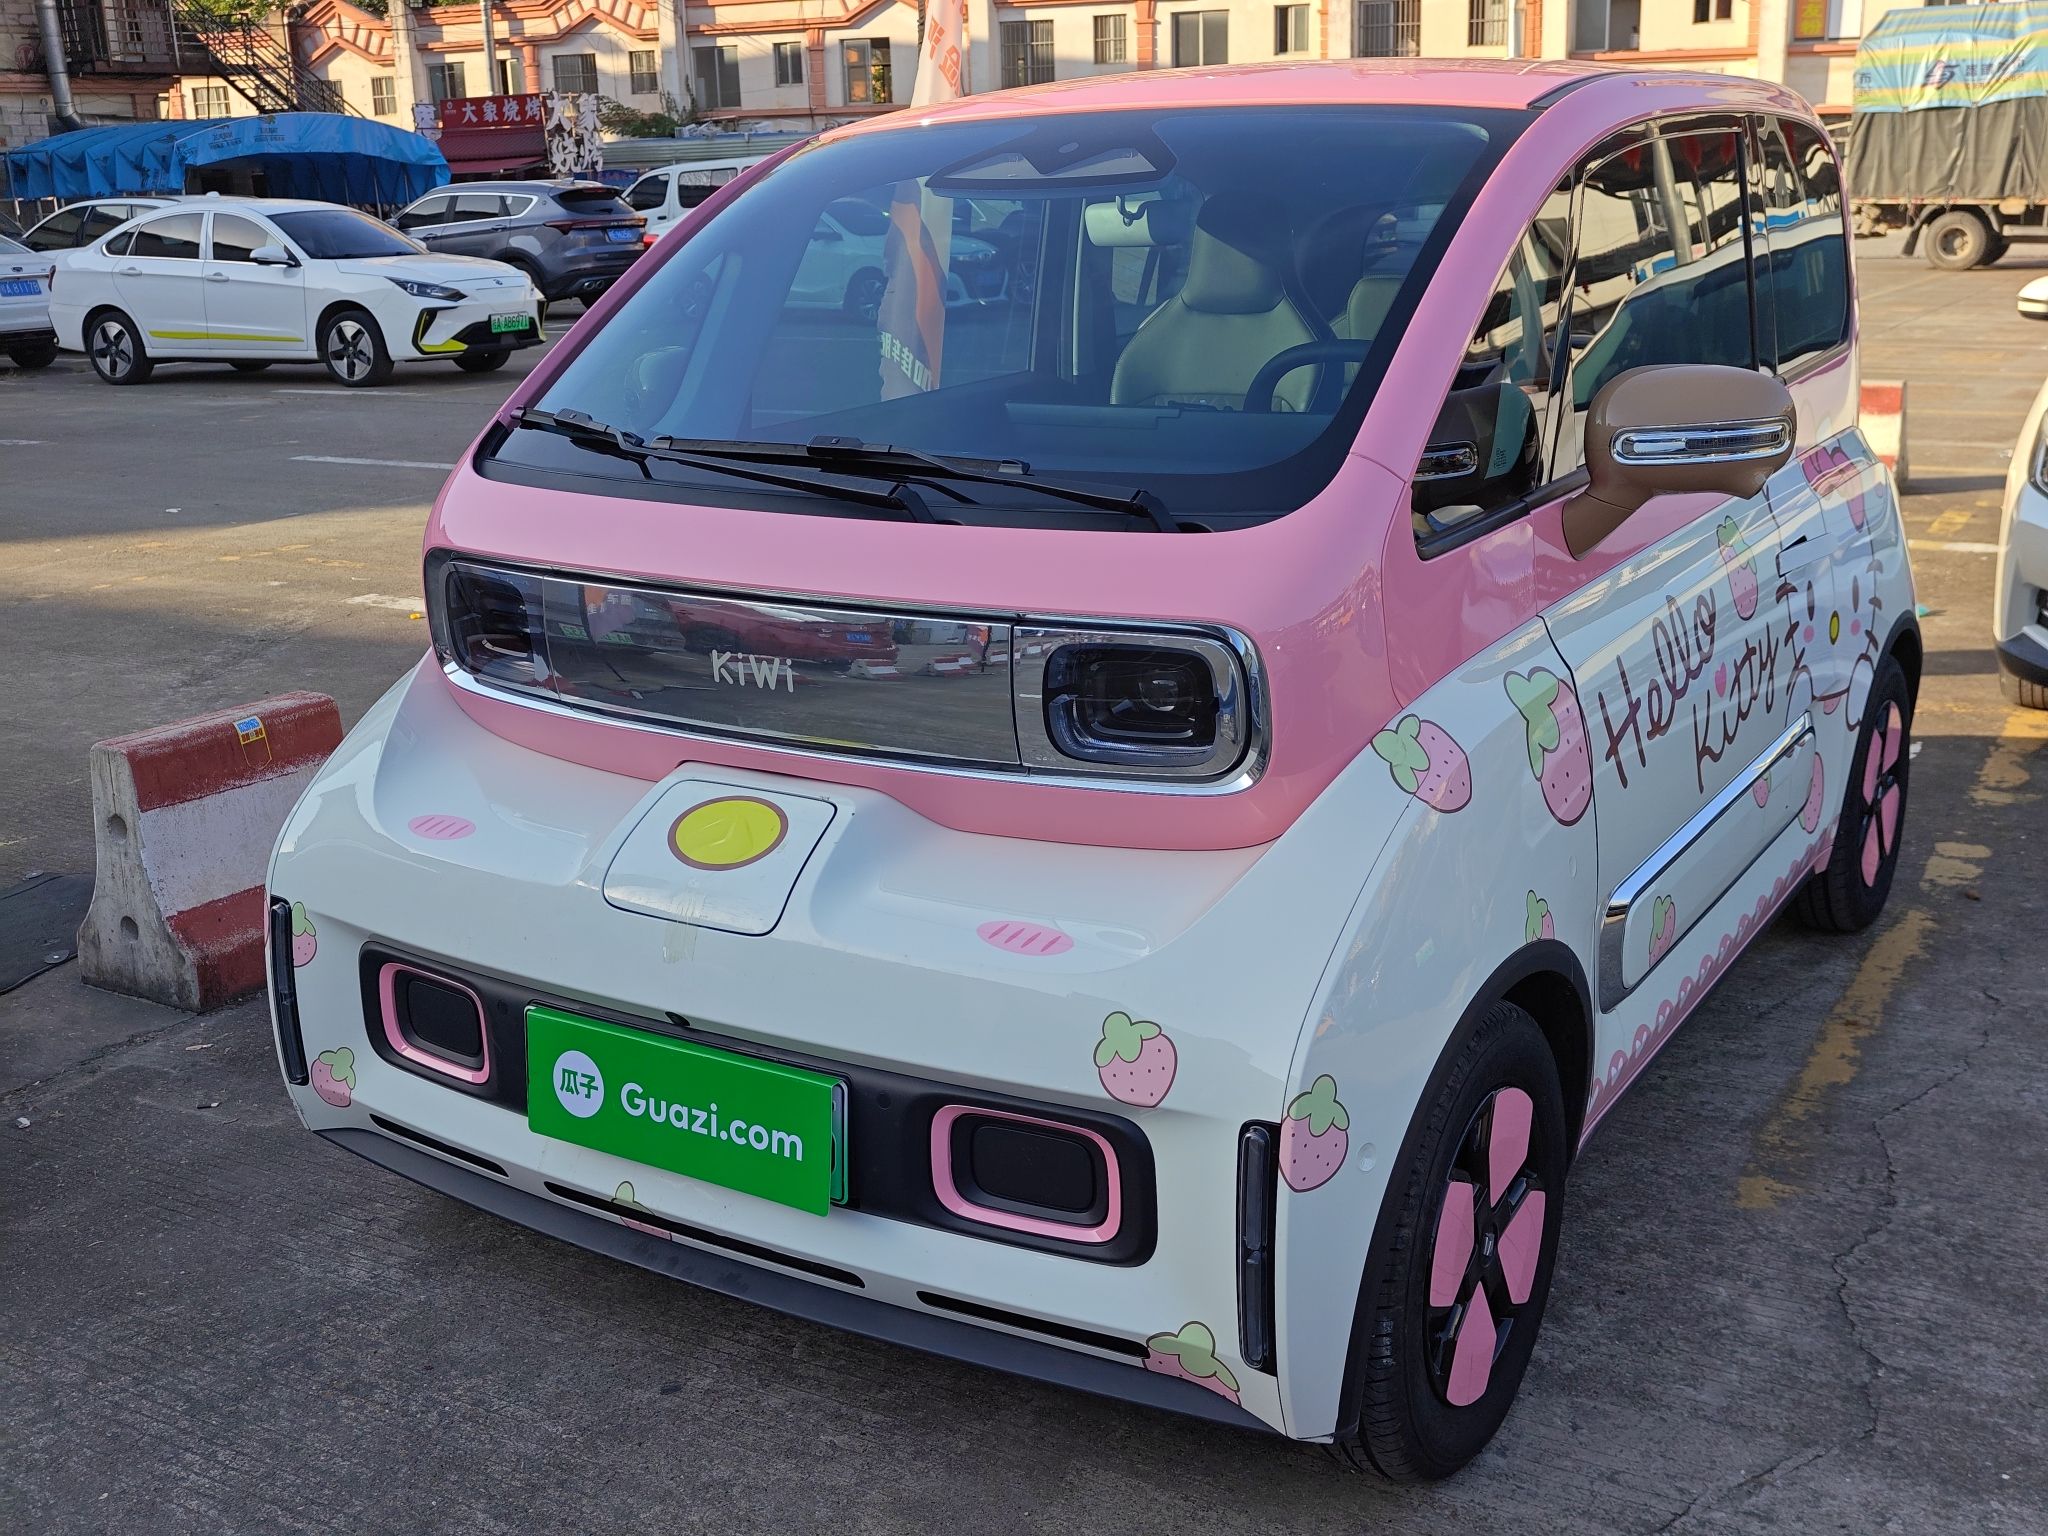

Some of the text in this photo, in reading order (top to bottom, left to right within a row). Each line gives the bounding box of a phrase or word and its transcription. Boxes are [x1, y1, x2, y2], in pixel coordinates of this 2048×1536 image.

[461, 95, 541, 124] 大象烧烤
[1598, 587, 1707, 789] Hello
[1693, 621, 1779, 794] Kitty
[559, 1067, 804, 1162] 瓜子 Guazi.com
